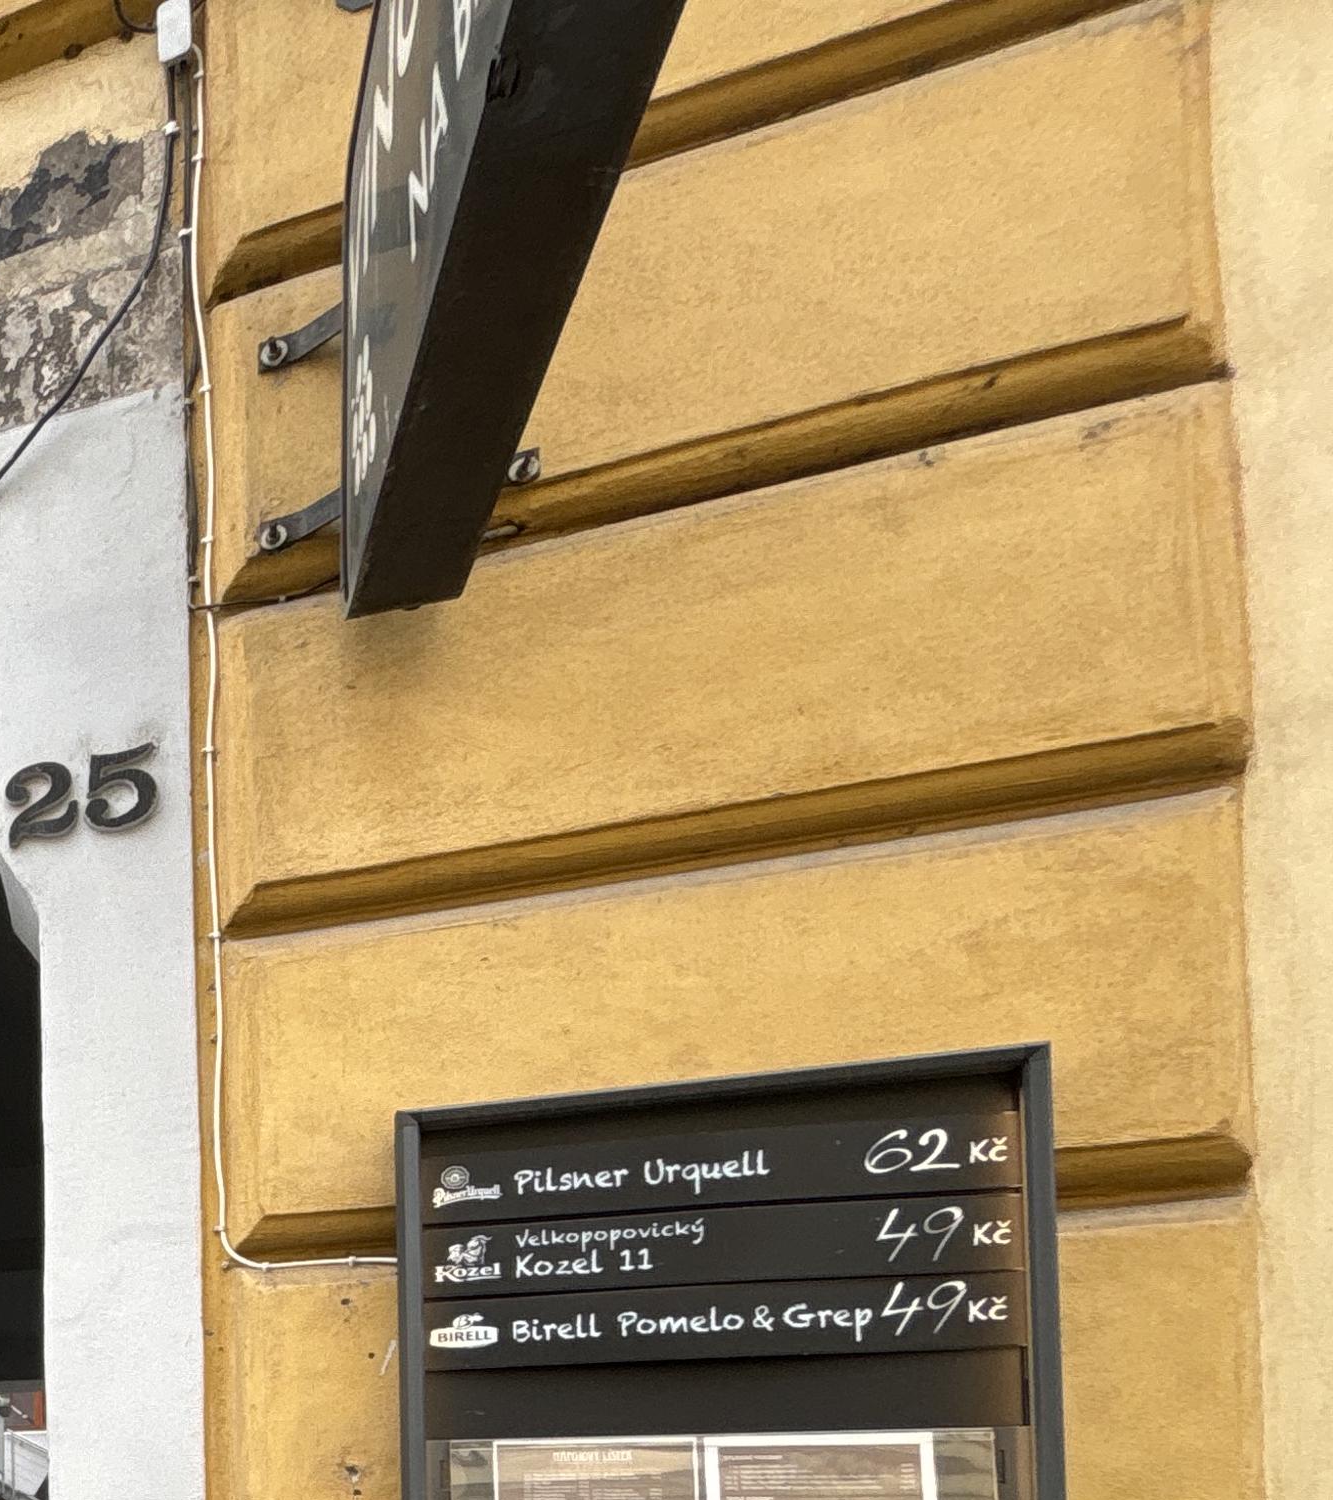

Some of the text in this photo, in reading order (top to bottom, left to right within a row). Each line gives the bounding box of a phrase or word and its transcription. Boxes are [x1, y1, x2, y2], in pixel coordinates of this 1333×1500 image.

[5, 741, 160, 850] 25
[513, 1127, 1009, 1195] Pilsner Urquell 62 Kč
[515, 1217, 705, 1252] Velkopopovický
[875, 1206, 1012, 1263] 49 Kč
[435, 1262, 502, 1283] Kozel
[515, 1248, 654, 1279] Kozel 11
[511, 1280, 1009, 1343] Birell Pomelo & Grep 49 Kč
[437, 1329, 492, 1343] BIRELL
